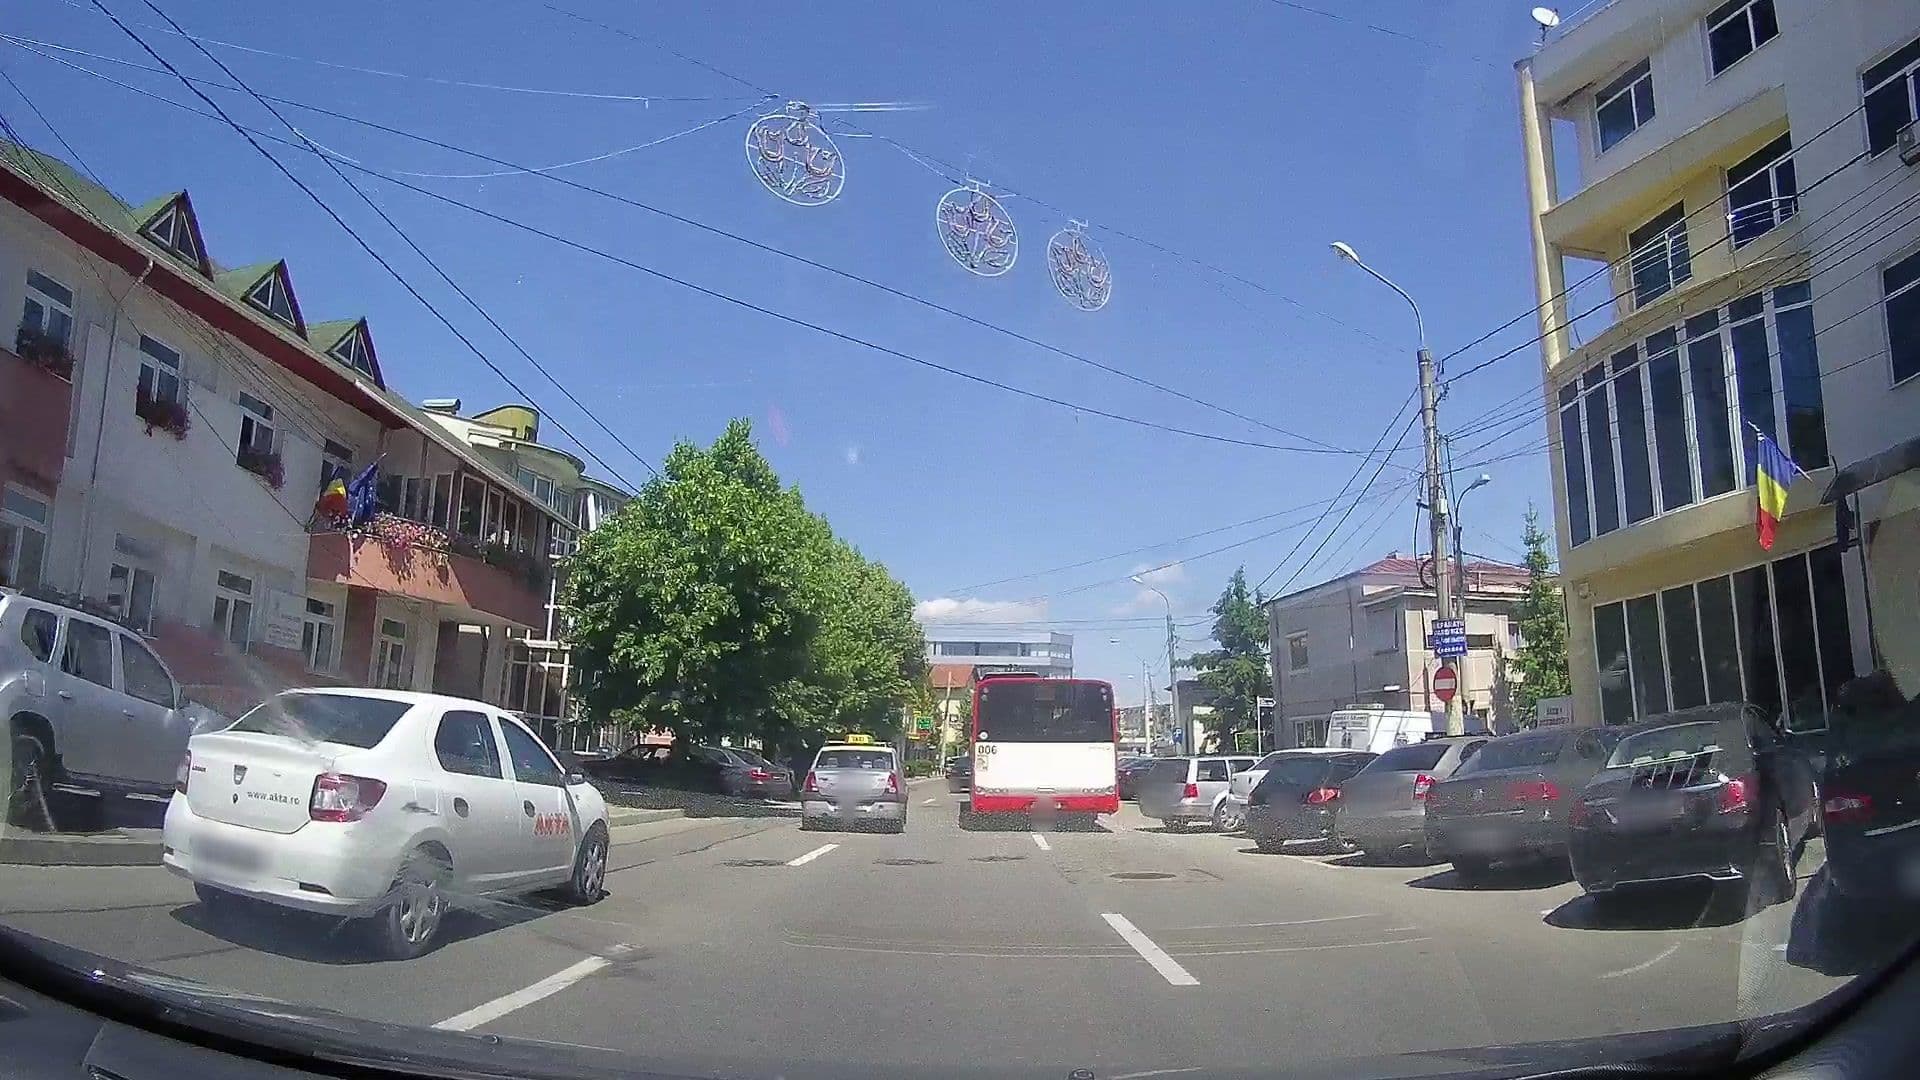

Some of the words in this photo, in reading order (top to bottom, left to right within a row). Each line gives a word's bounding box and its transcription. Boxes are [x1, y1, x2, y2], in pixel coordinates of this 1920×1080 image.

[978, 744, 997, 755] 006
[247, 791, 300, 805] www.akta.ro
[534, 812, 570, 835] AKTA
